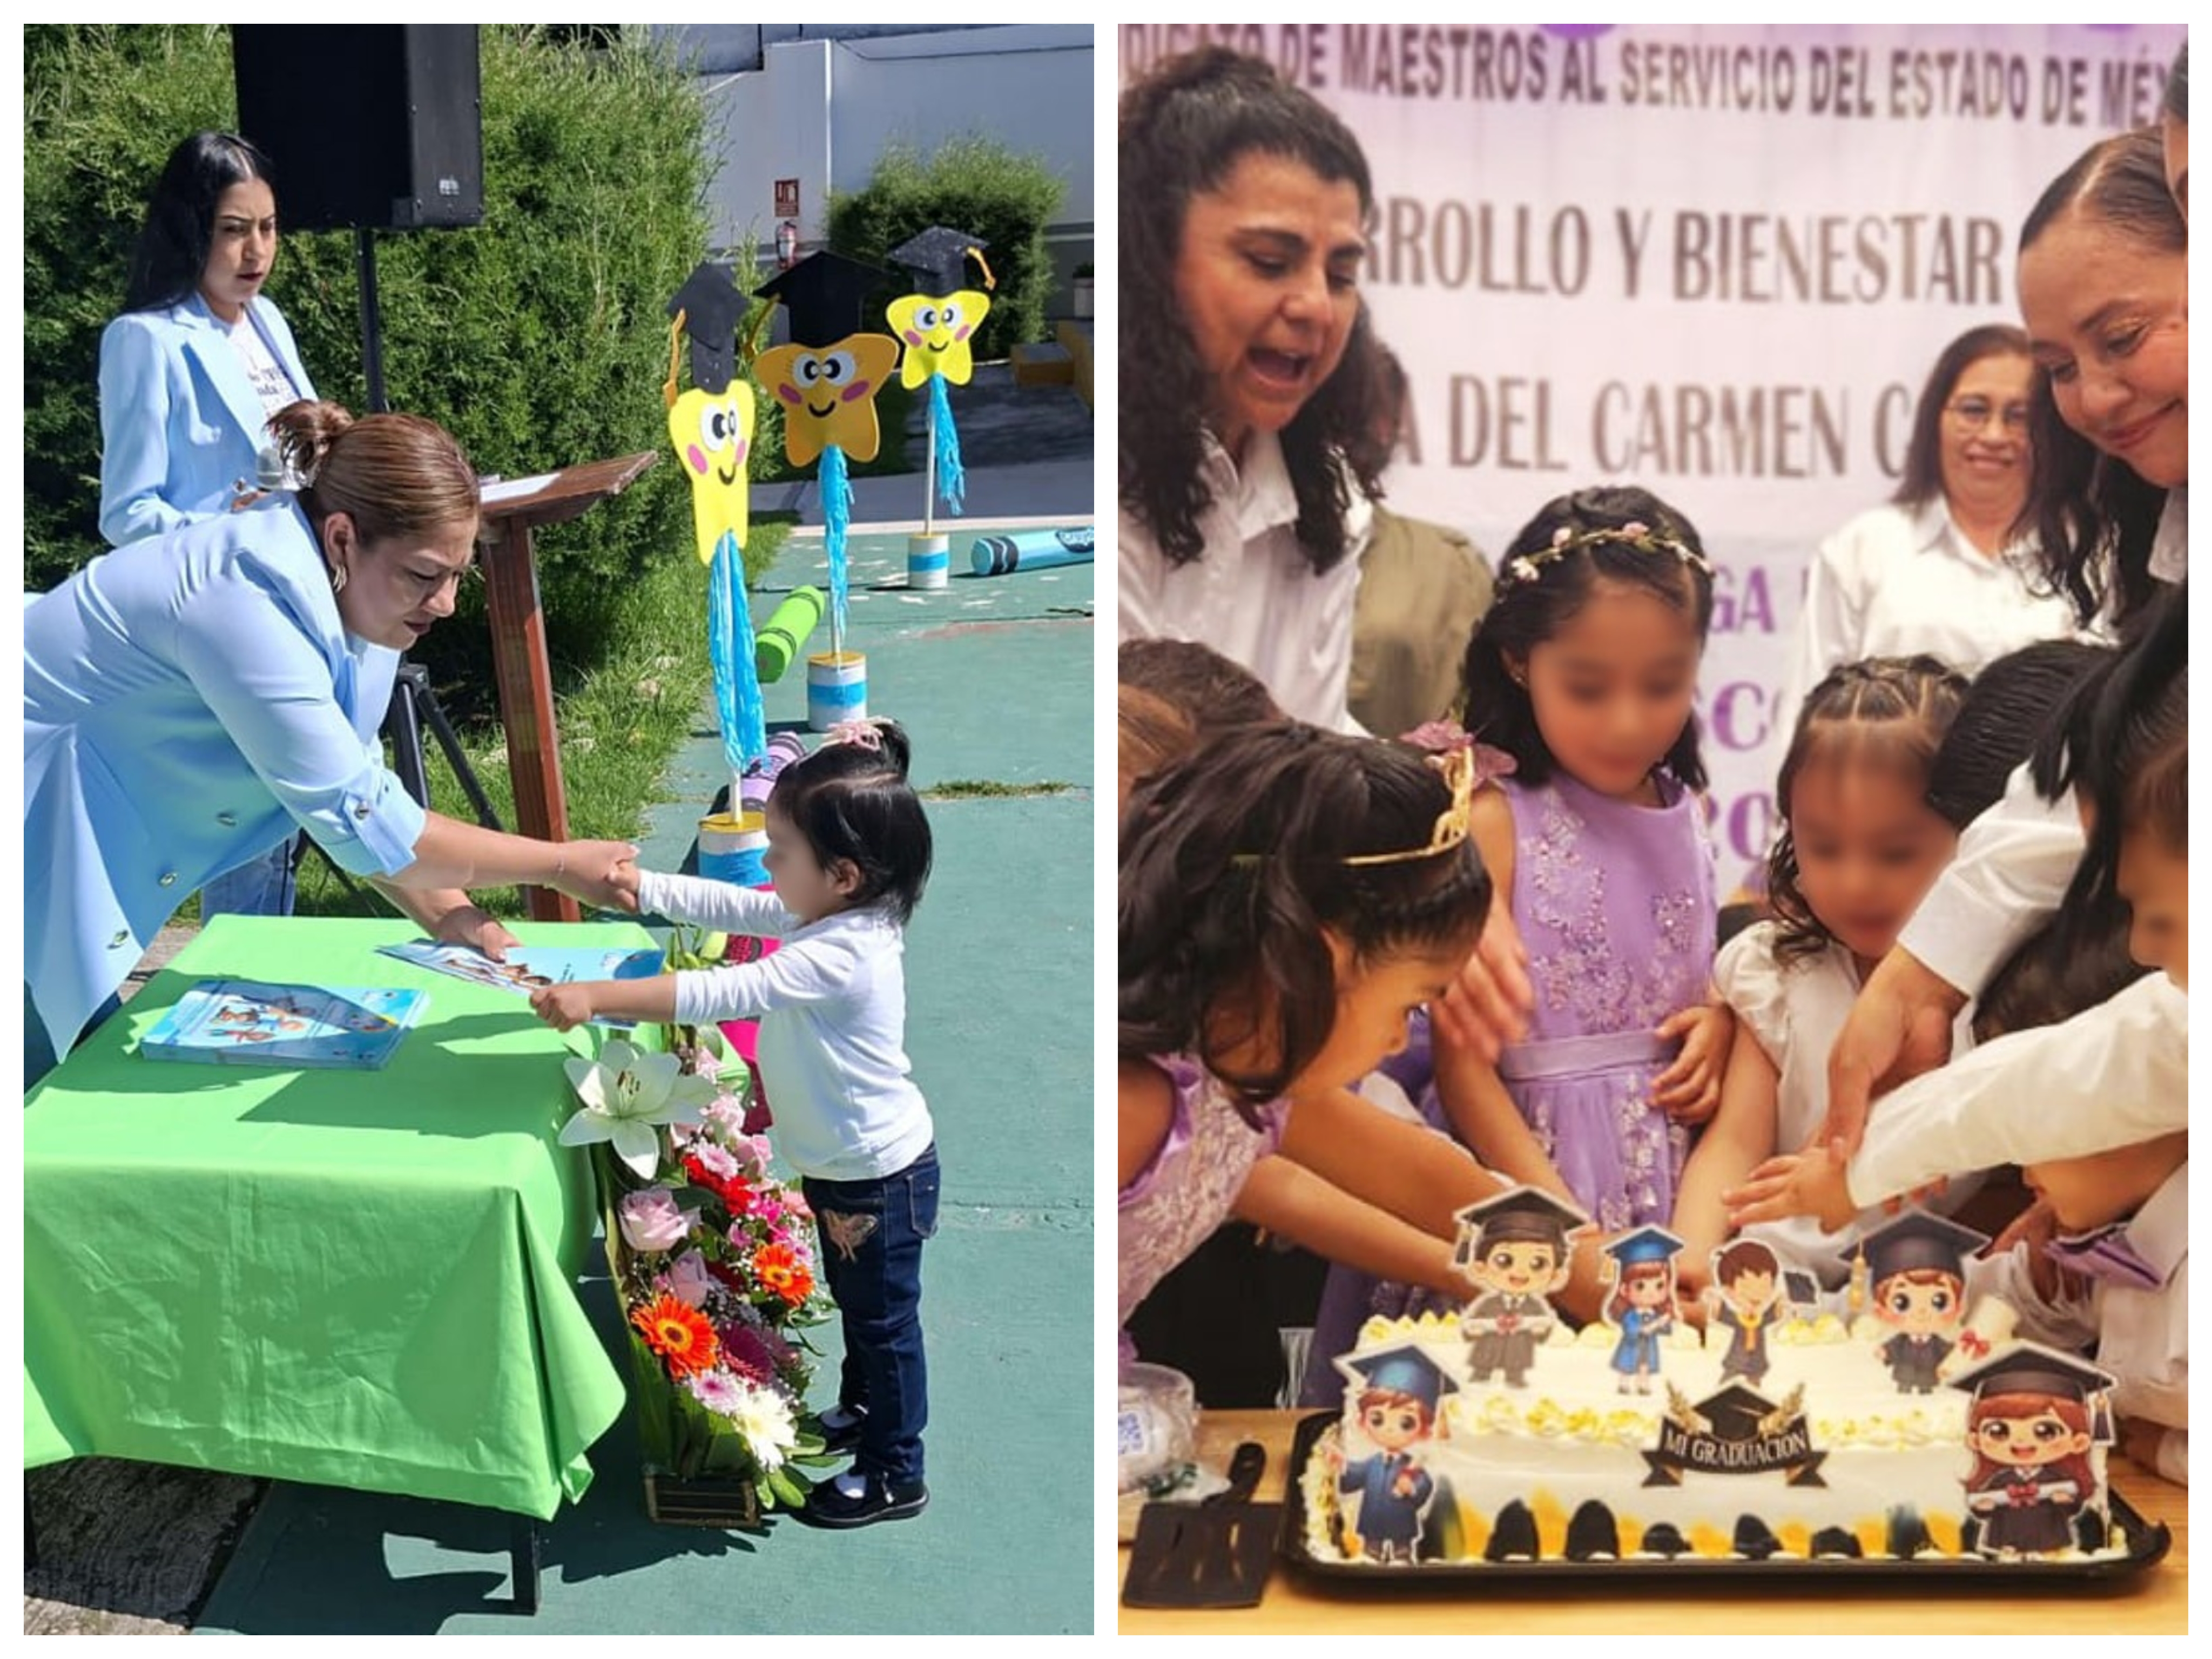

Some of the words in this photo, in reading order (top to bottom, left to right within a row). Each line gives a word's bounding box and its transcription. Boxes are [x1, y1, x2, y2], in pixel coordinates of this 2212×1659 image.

[1280, 24, 1327, 87] DE
[1340, 24, 1546, 102] MAESTROS
[1560, 39, 1606, 103] AL
[1619, 40, 1795, 112] SERVICIO
[1809, 46, 1875, 117] DEL
[1889, 50, 2028, 121] ESTADO
[2041, 55, 2087, 126] DE
[1614, 205, 1653, 299] Y
[1673, 210, 2004, 305] BIENESTAR
[1449, 373, 1569, 472] DEL
[1590, 379, 1848, 478] CARMEN
[1664, 1428, 1688, 1457] MI
